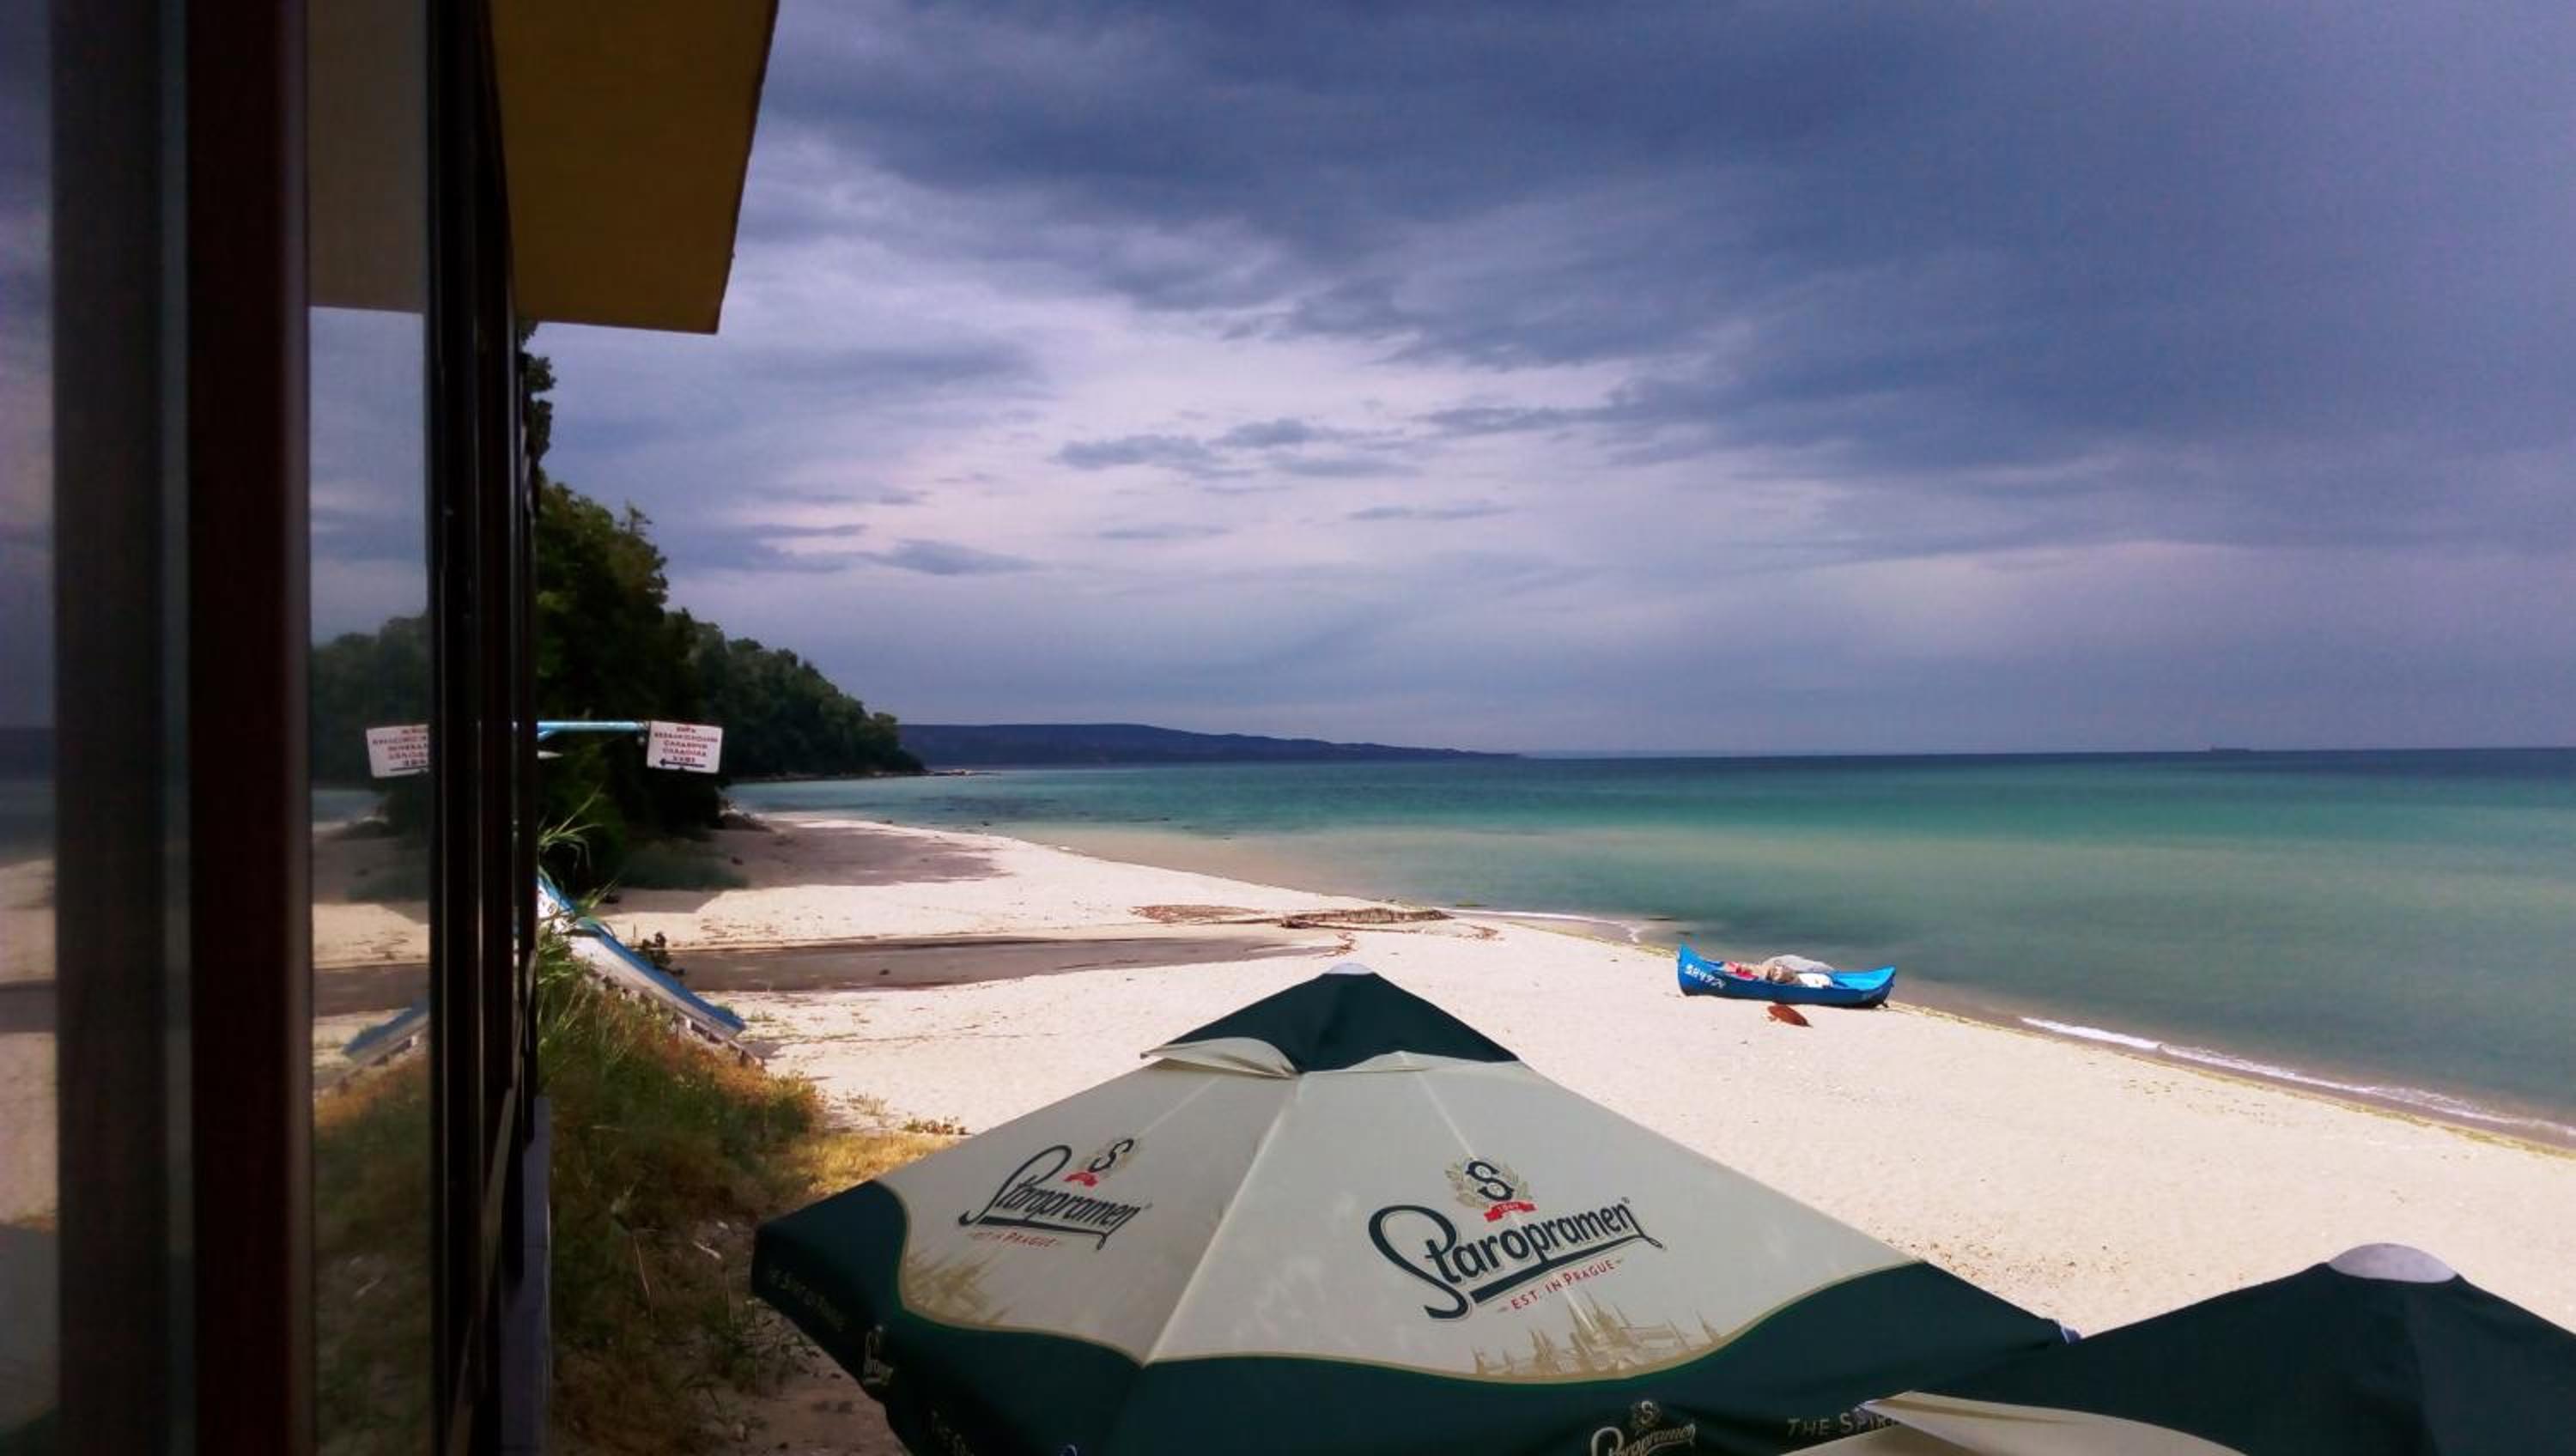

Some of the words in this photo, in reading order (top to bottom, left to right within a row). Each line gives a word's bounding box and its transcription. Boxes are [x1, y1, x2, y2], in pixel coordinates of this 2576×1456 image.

[958, 1144, 1142, 1251] Staropramen
[1465, 1161, 1514, 1201] S
[1368, 1204, 1663, 1320] Staropramen
[1563, 1259, 1615, 1286] PRAGUE
[1787, 1417, 1830, 1436] THE
